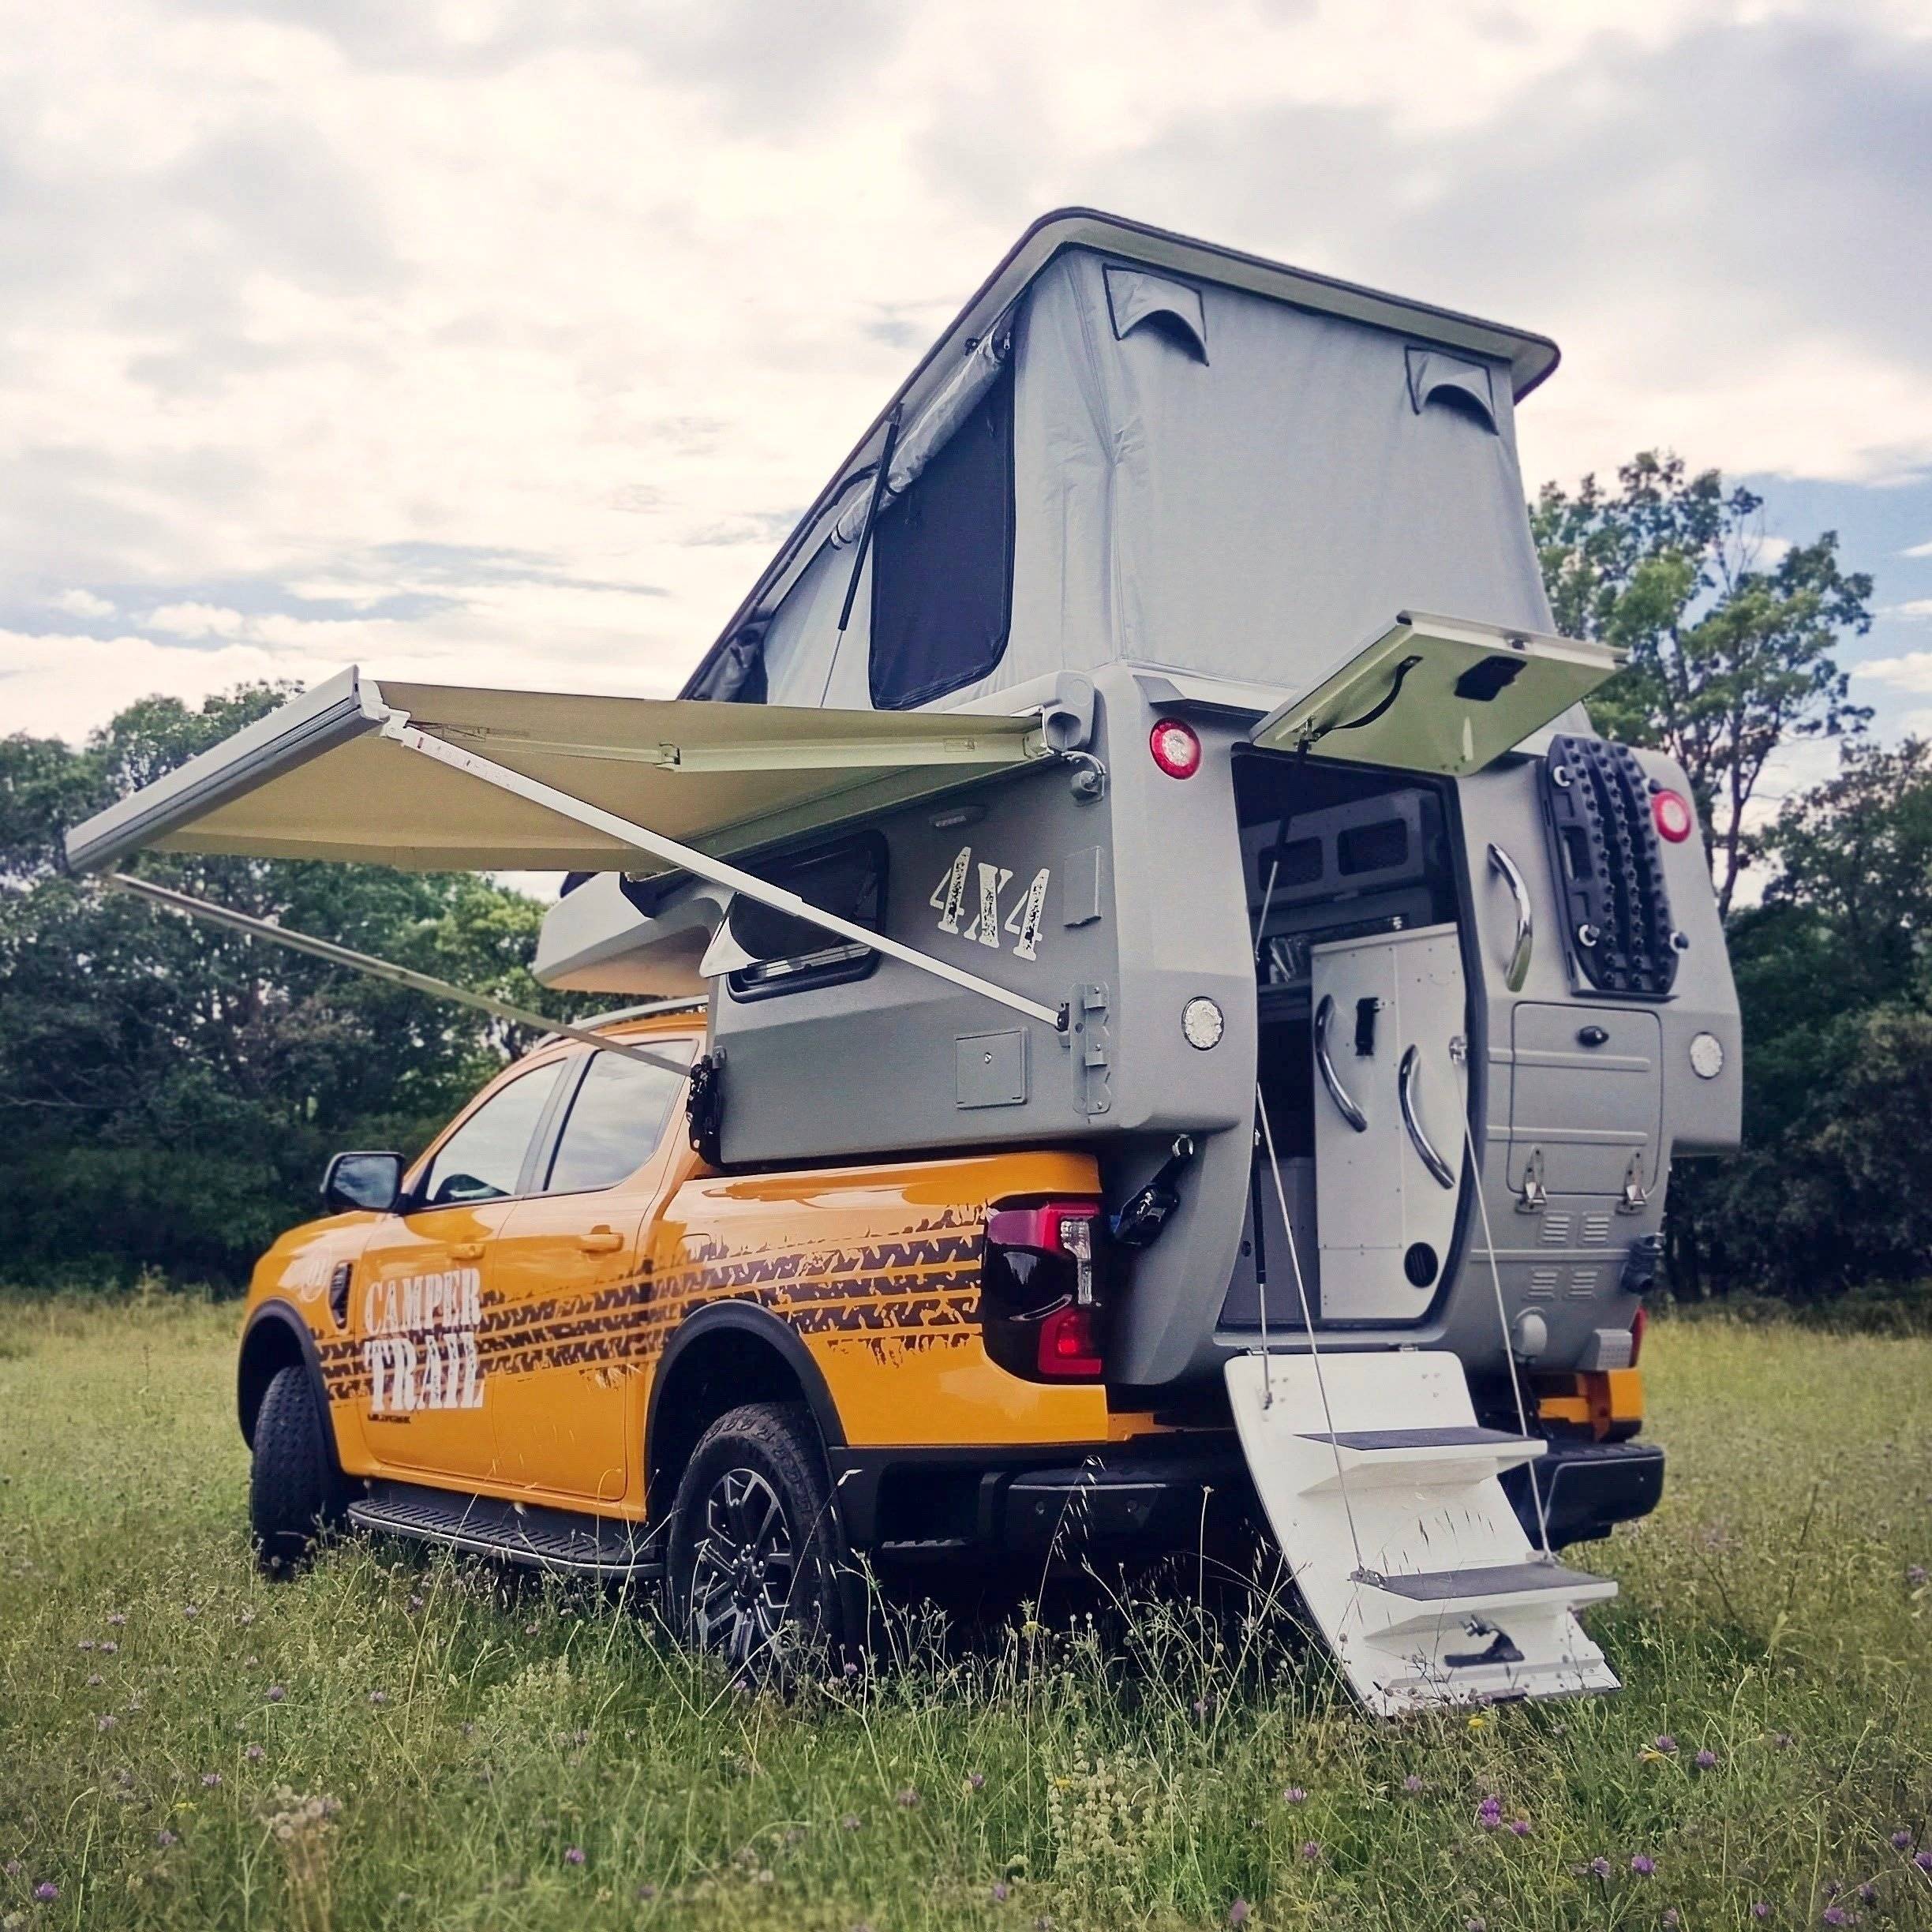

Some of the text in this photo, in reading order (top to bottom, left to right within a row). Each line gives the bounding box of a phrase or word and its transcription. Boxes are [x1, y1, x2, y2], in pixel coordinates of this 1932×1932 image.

[930, 846, 1050, 961] 4X4
[365, 1268, 481, 1336] CAMPER
[364, 1331, 485, 1412] TRAIL
